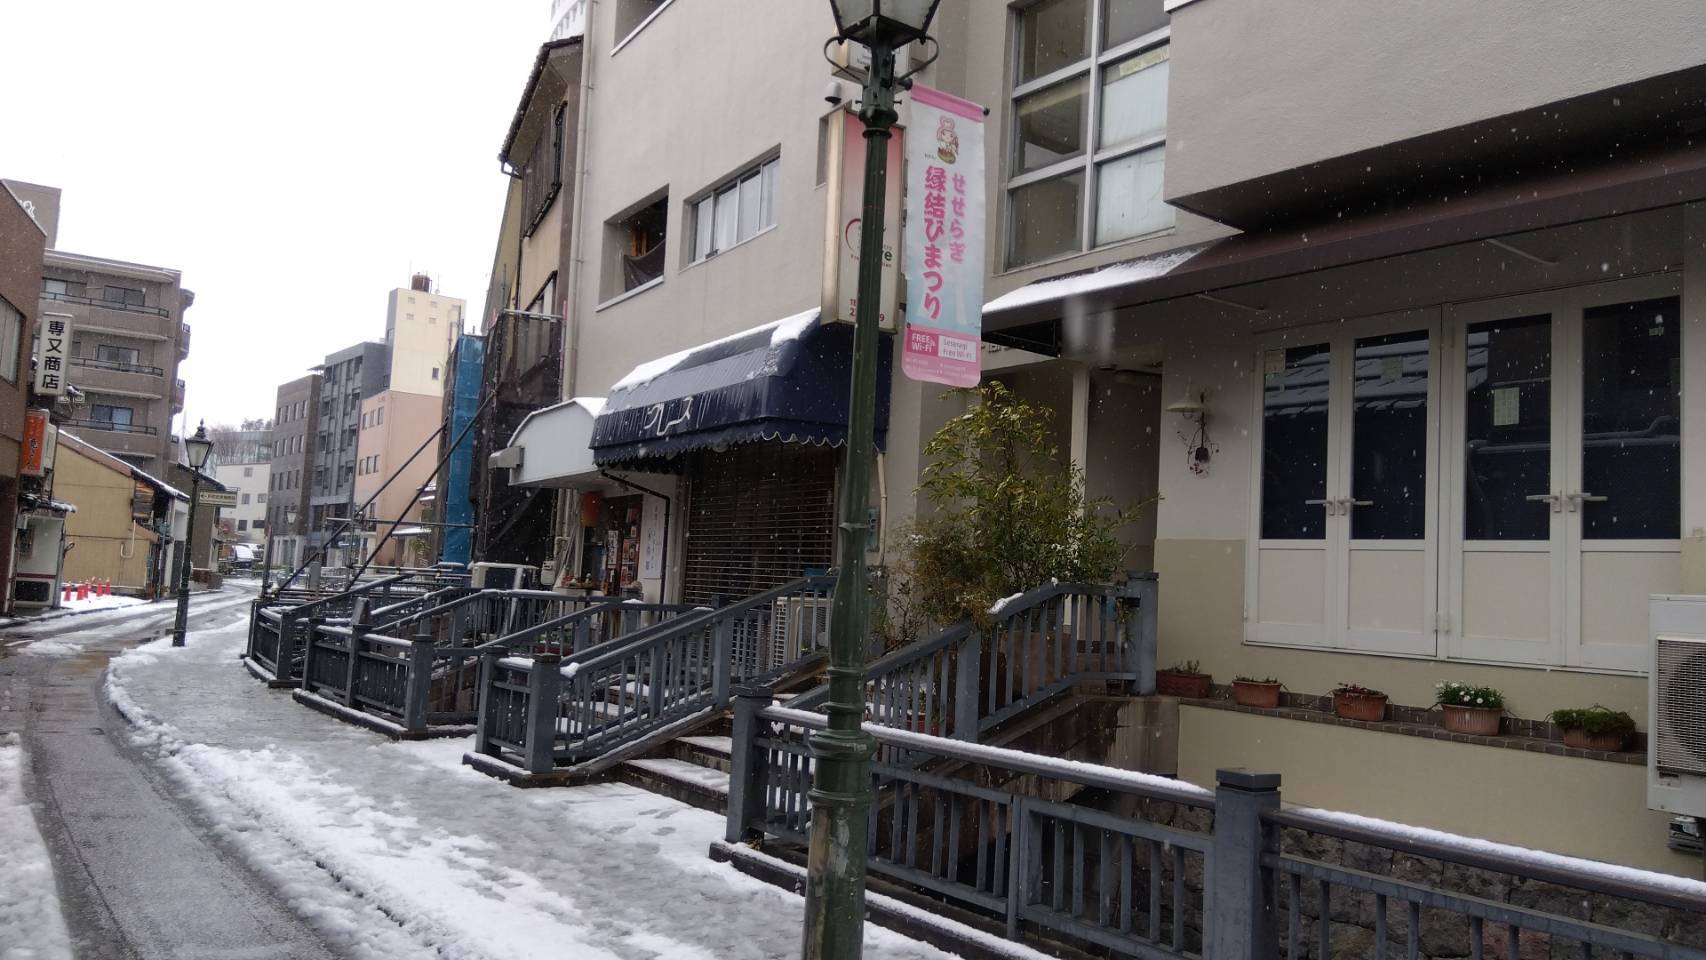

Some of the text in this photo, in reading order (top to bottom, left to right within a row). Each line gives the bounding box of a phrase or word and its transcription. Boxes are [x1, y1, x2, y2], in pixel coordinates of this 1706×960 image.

[922, 166, 947, 320] 縁結びまつり
[949, 173, 967, 263] せせらぎ
[42, 320, 66, 389] 専又商店
[911, 333, 930, 343] FREE
[911, 341, 932, 353] Wi-Fi
